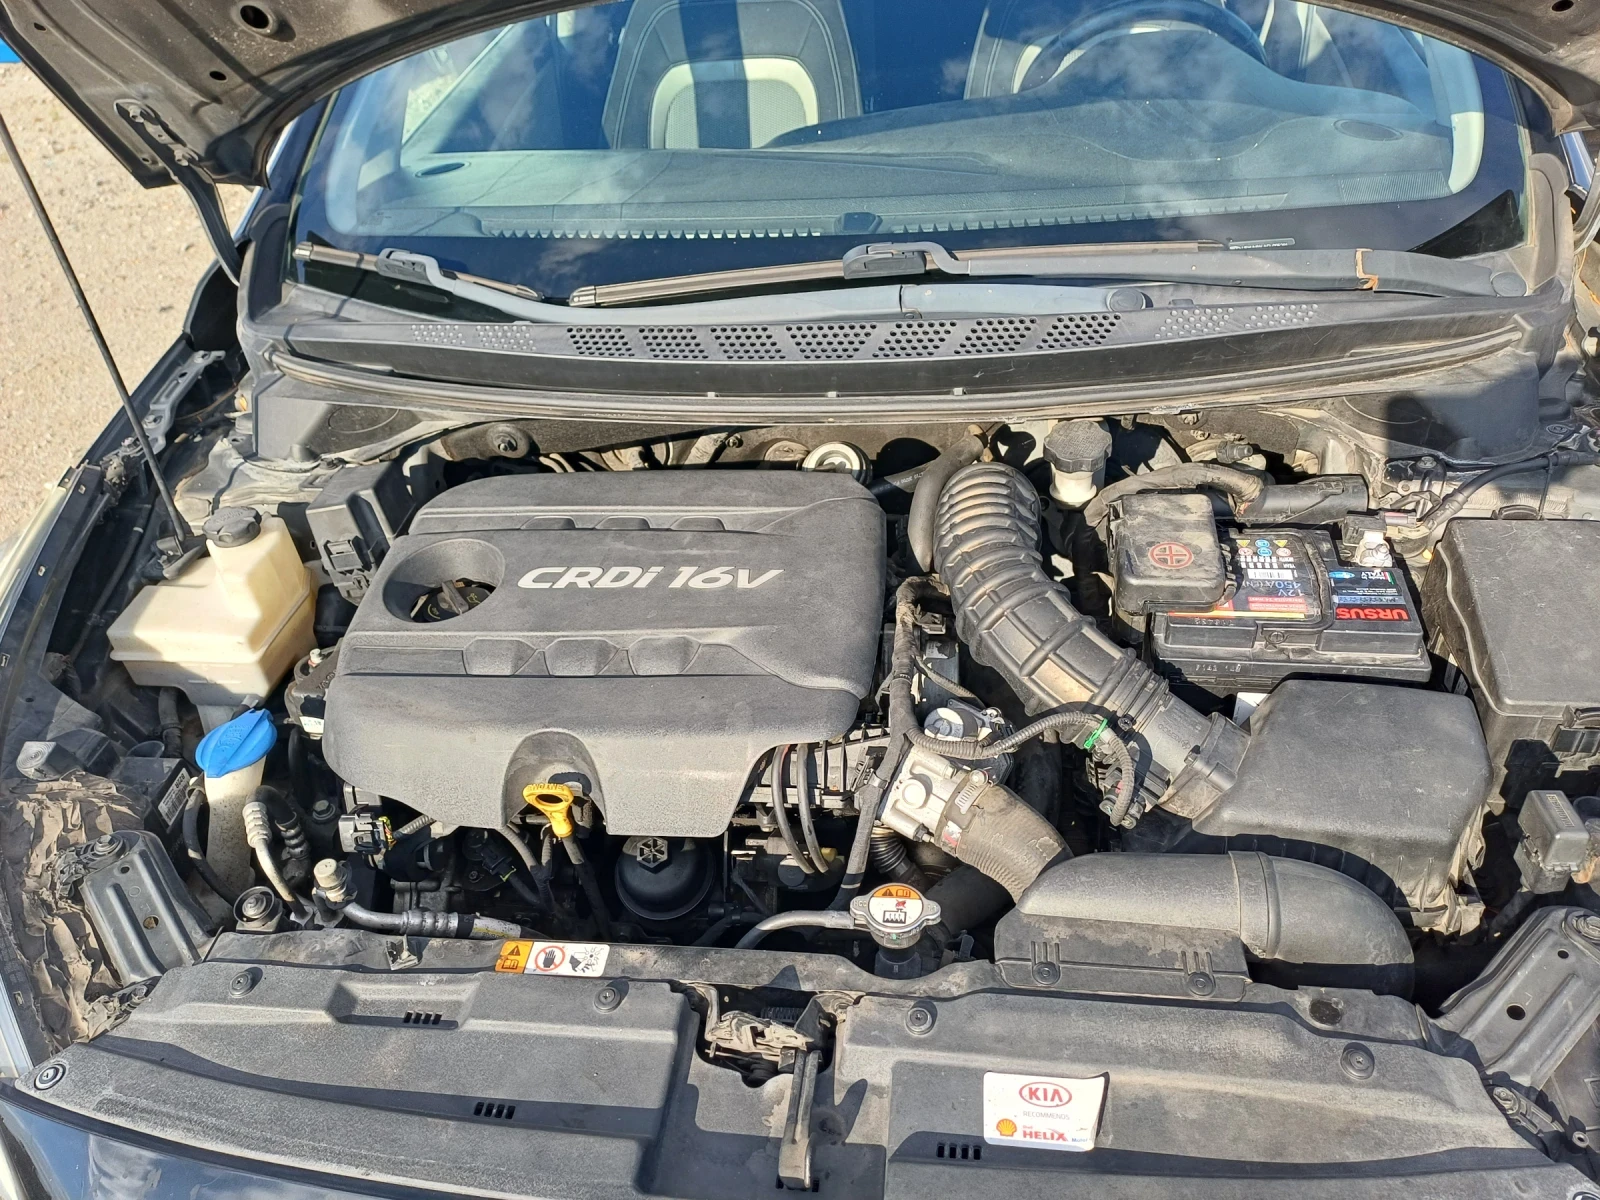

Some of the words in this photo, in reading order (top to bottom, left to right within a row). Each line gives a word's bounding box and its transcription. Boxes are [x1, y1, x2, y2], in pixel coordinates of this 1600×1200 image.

[517, 566, 665, 588] CRDi
[668, 566, 785, 588] 16V
[1336, 607, 1409, 620] URSUS
[1028, 1087, 1064, 1103] KIA
[1022, 1110, 1070, 1121] RECOMMENDS
[1022, 1129, 1069, 1142] HELIX
